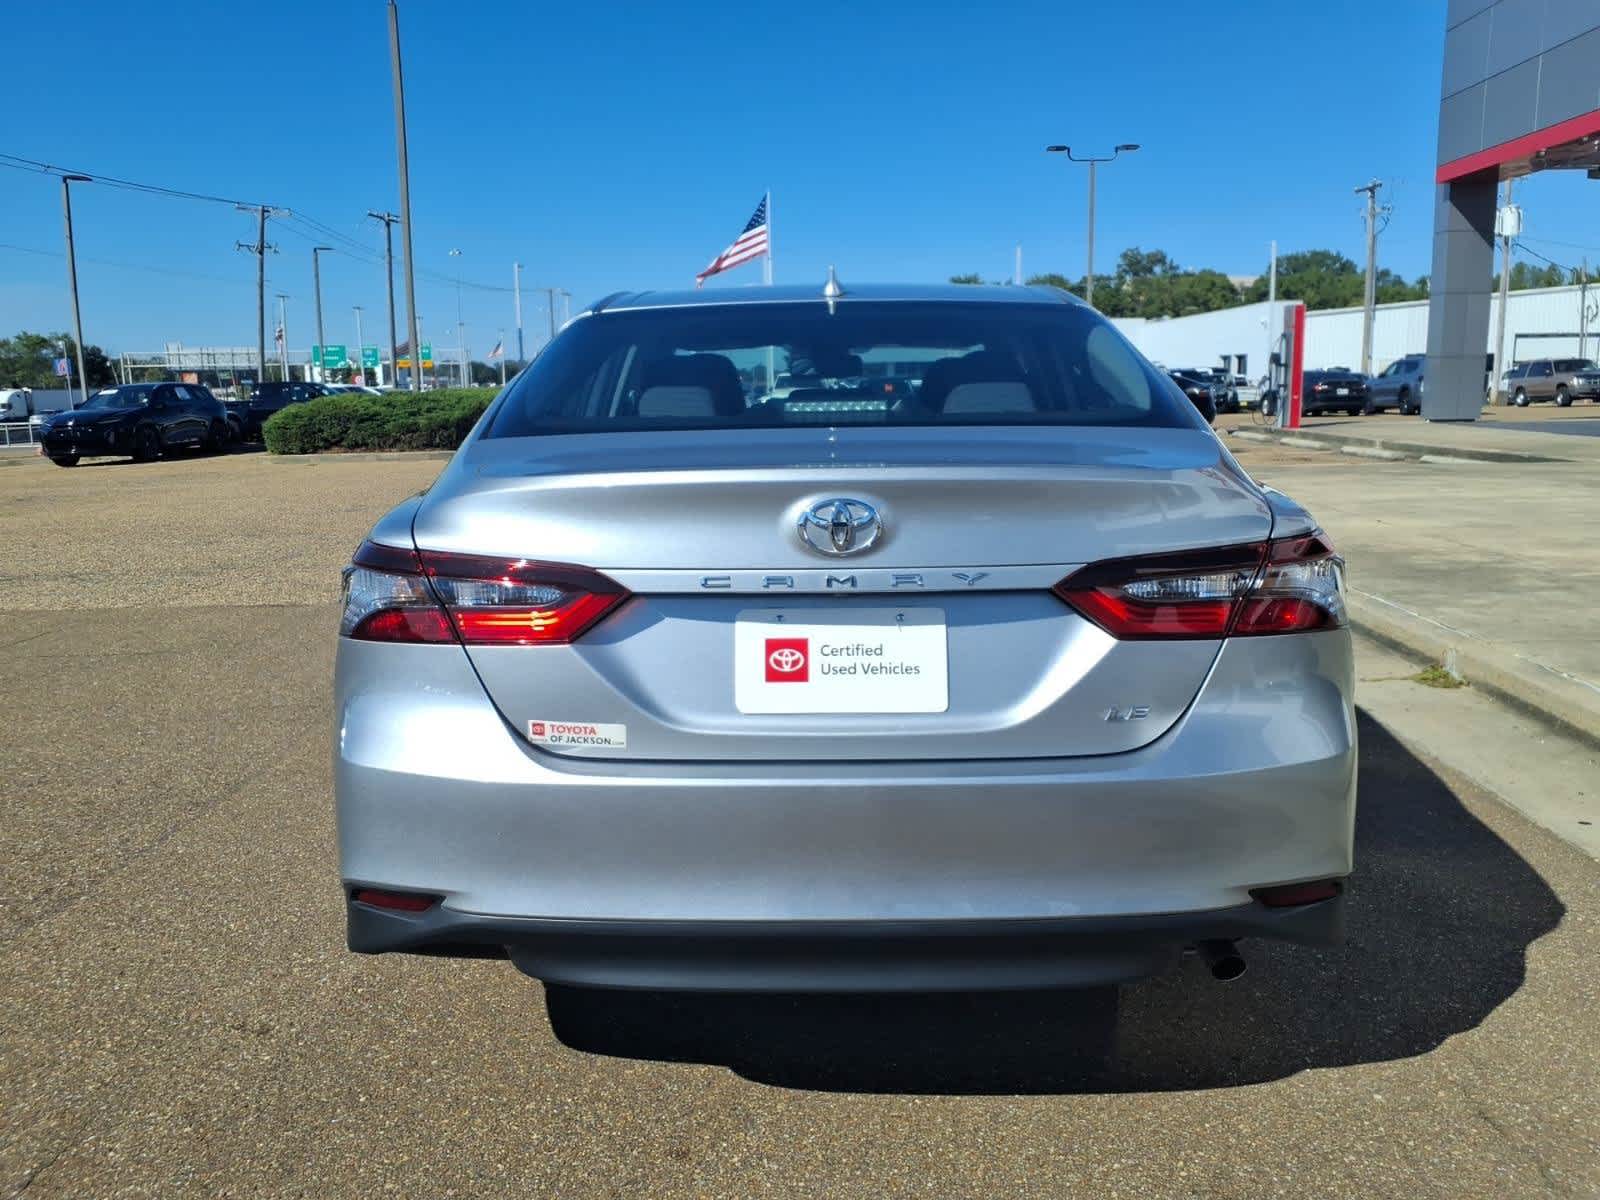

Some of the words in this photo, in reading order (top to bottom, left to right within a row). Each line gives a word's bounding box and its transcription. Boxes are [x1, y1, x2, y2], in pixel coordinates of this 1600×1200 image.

[700, 574, 989, 589] CAMRY
[820, 644, 883, 657] Certified
[820, 663, 857, 676] Used
[861, 663, 920, 676] Vehicles
[1104, 704, 1151, 721] LE
[549, 724, 597, 736] TOYOTA
[550, 735, 563, 743] OF
